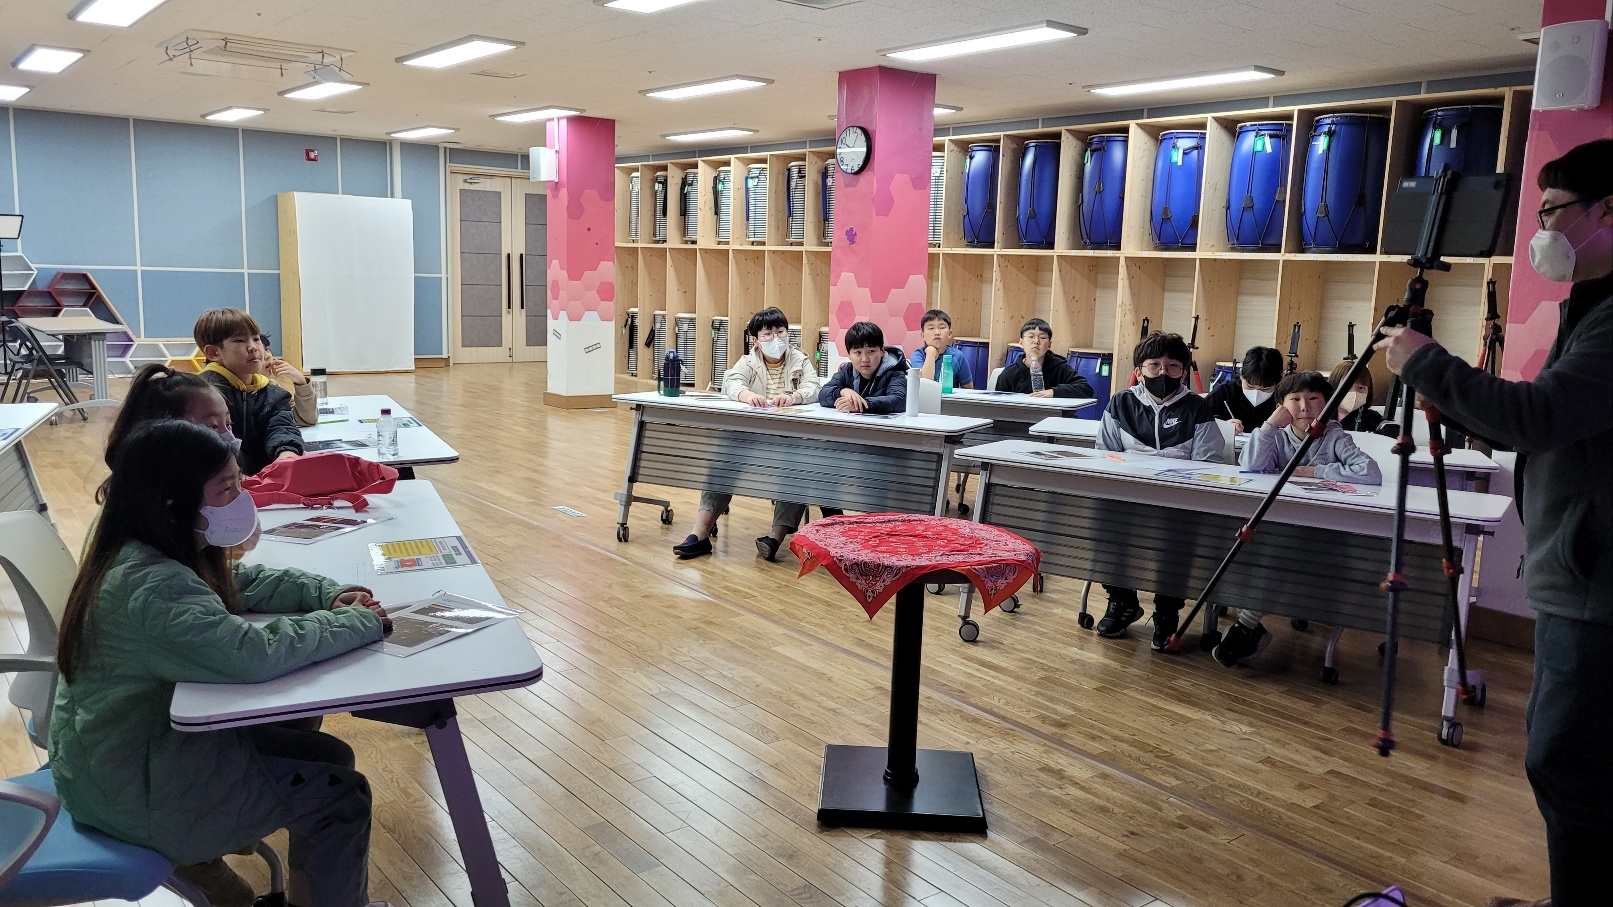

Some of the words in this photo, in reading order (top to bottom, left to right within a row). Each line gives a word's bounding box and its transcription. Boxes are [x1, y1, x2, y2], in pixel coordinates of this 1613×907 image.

[845, 129, 850, 137] 11
[840, 136, 846, 145] 10
[839, 156, 844, 166] 8
